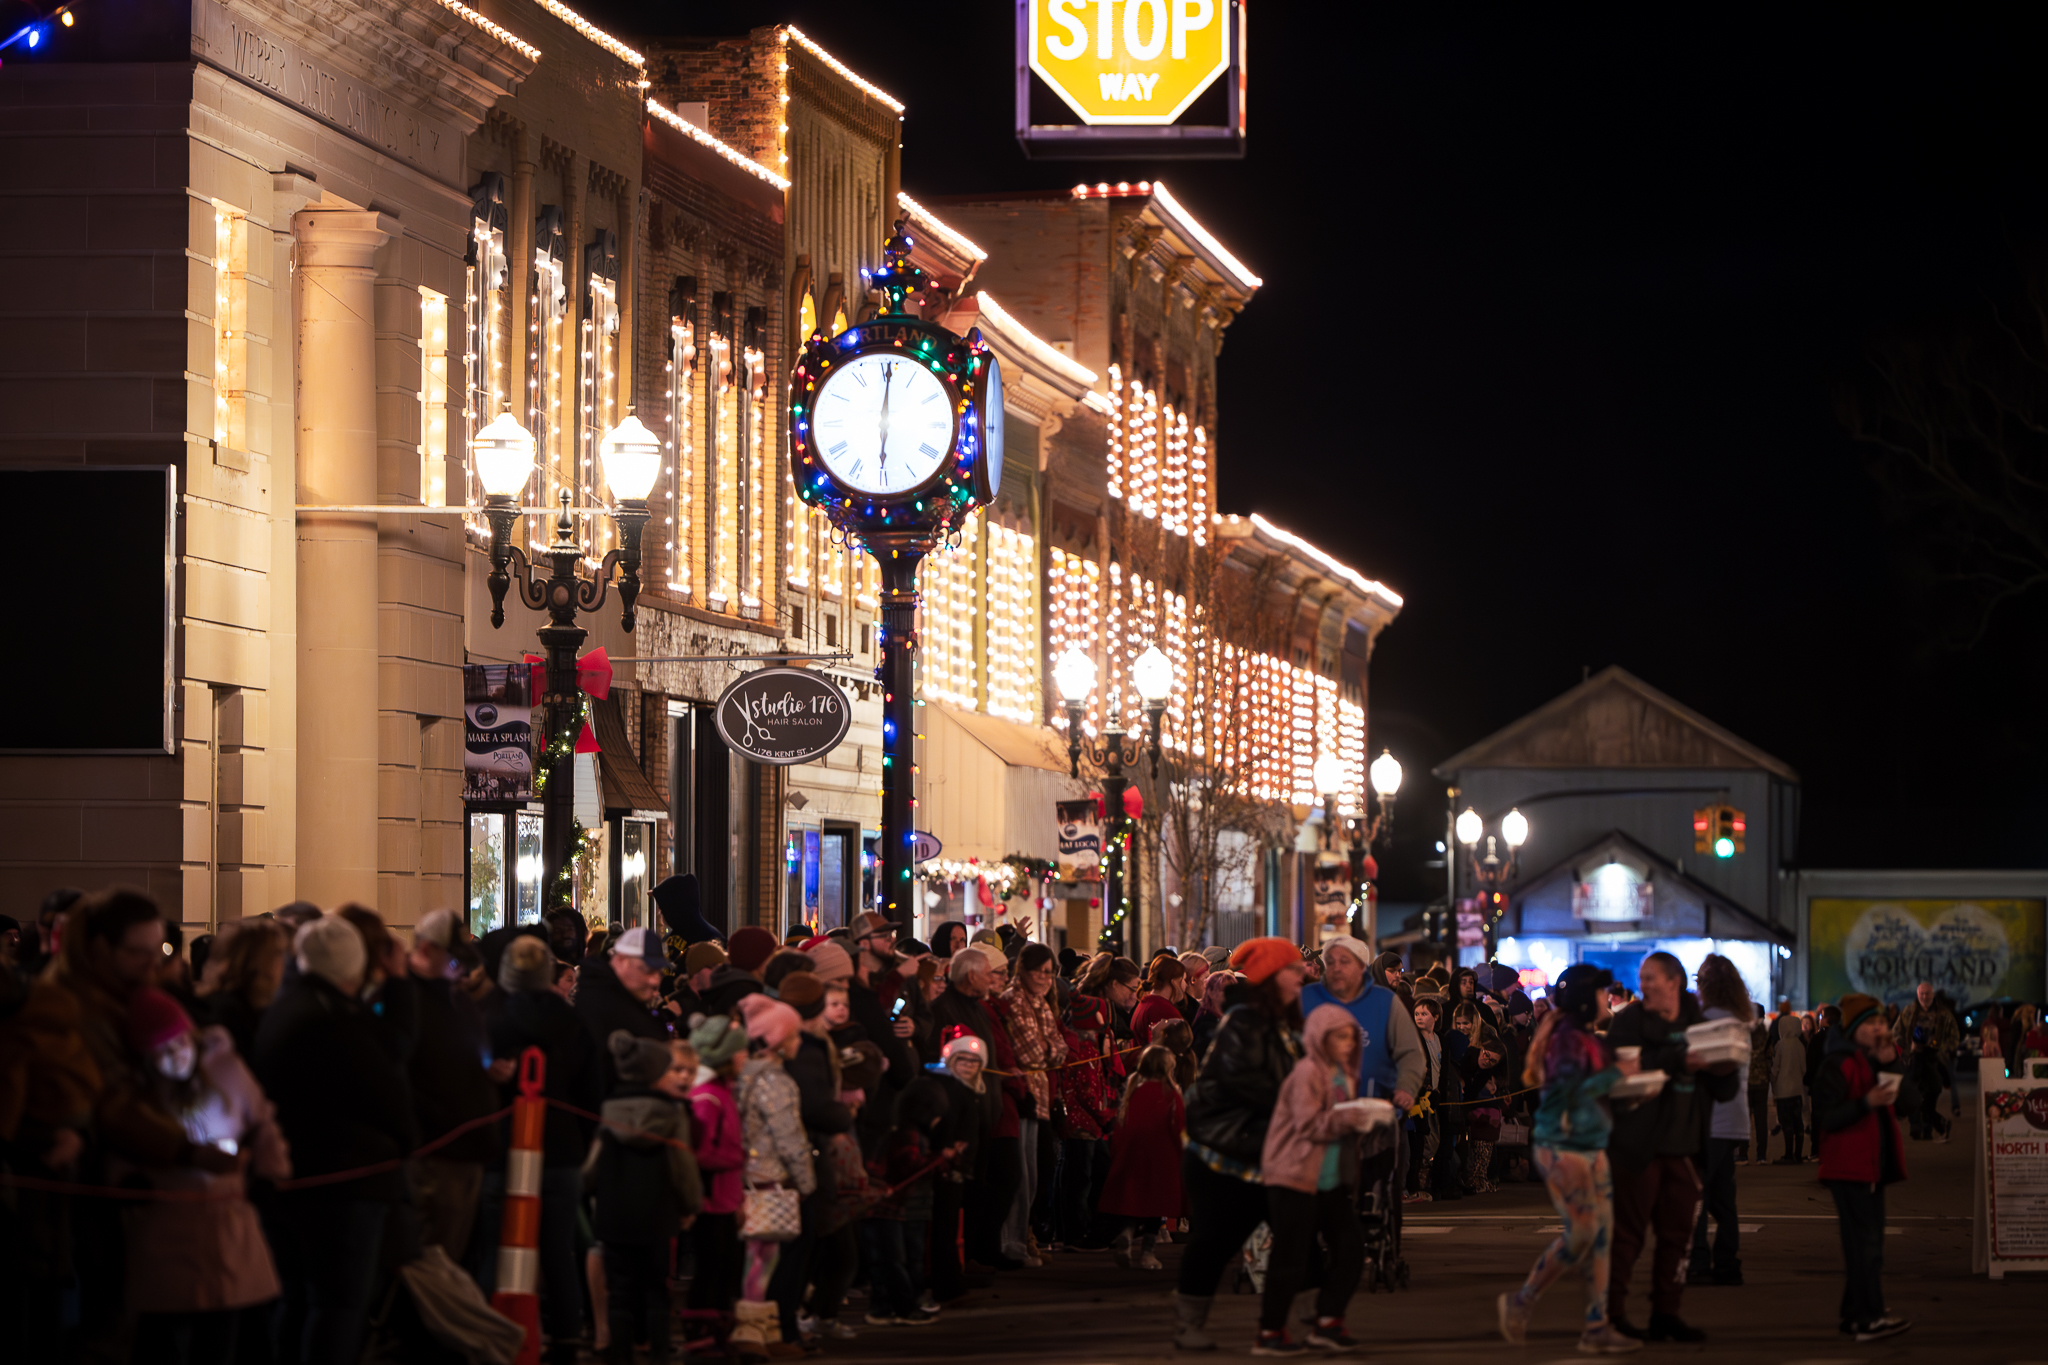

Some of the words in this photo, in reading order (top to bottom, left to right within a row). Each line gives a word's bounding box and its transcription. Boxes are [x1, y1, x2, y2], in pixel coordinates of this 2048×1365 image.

[1046, 0, 1214, 61] STOP
[231, 21, 288, 96] WEBBER
[299, 60, 337, 121] STATE
[1098, 73, 1160, 102] WAY
[831, 325, 937, 355] PRTLAND
[751, 691, 806, 719] studio
[809, 695, 838, 714] 176
[767, 718, 789, 726] HAIR
[792, 718, 823, 726] SALON
[467, 733, 490, 743] MAKE
[492, 733, 499, 743] A
[500, 733, 531, 743] SPLASH
[757, 747, 773, 757] 176
[774, 750, 795, 758] KENT
[1859, 956, 1997, 979] PORTLAND
[1996, 1142, 2040, 1155] NORTH
